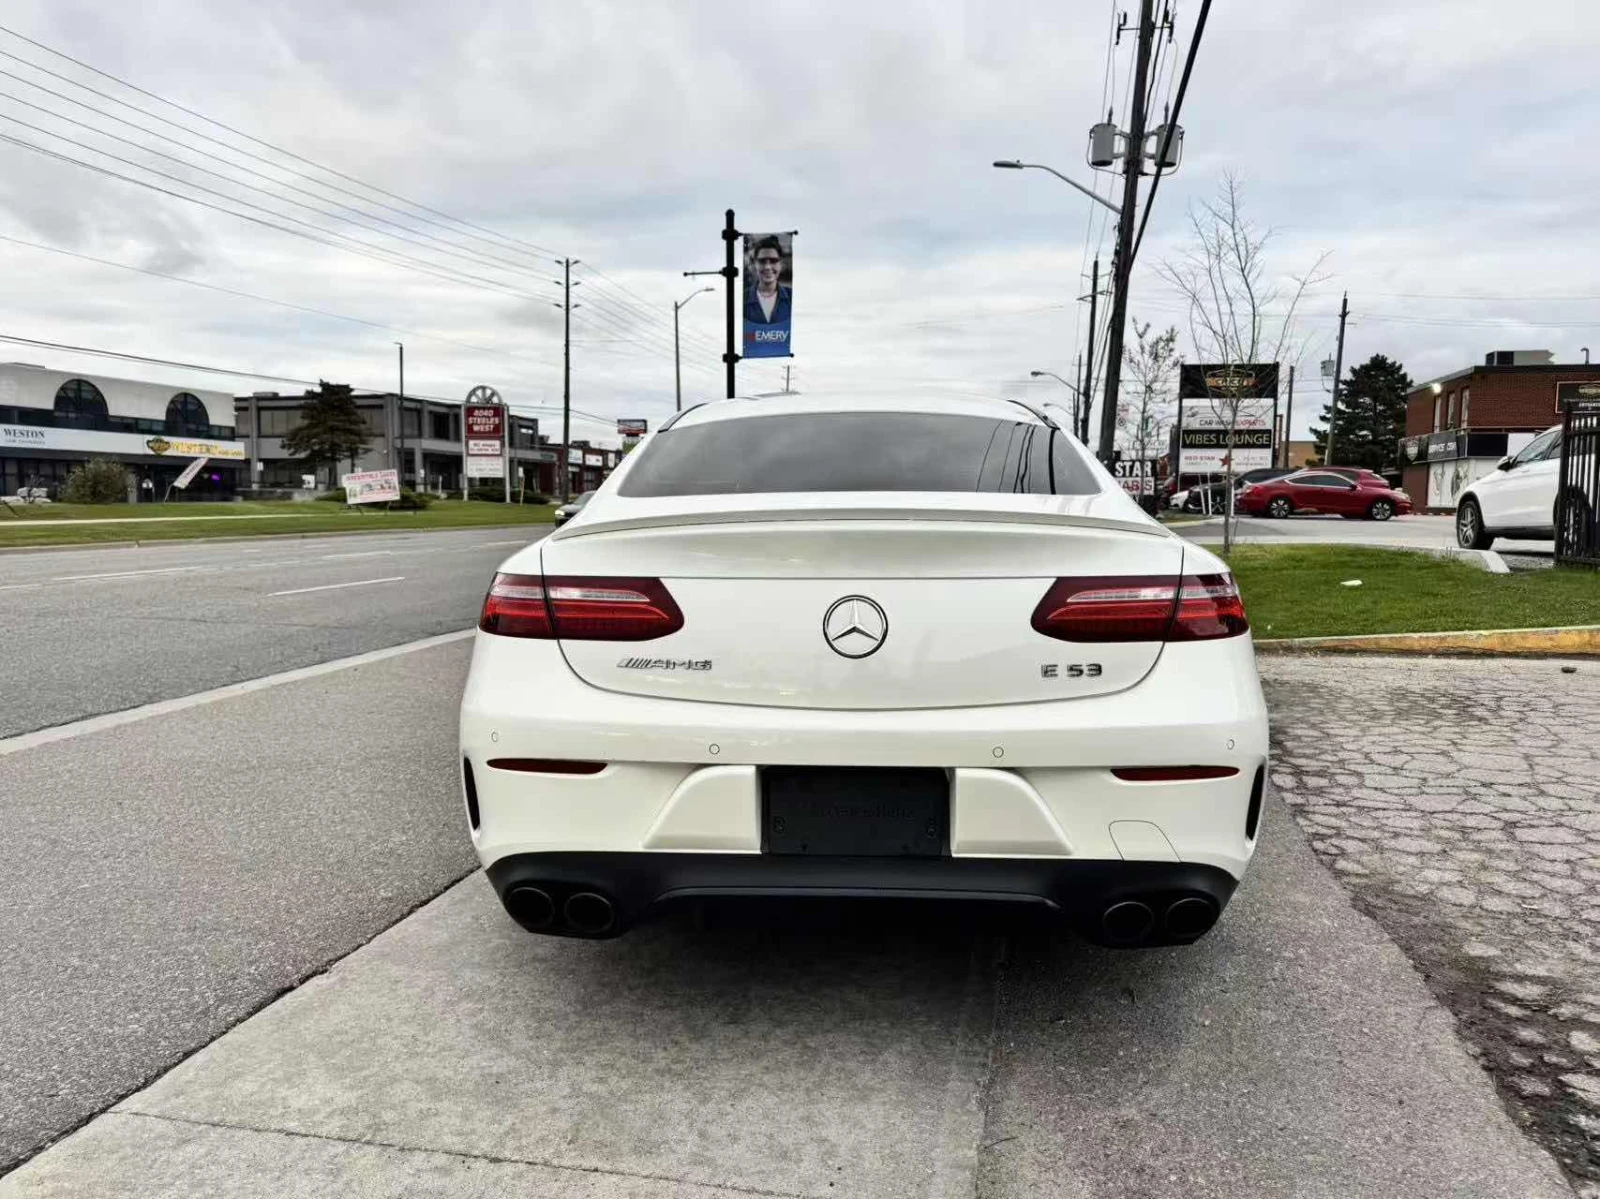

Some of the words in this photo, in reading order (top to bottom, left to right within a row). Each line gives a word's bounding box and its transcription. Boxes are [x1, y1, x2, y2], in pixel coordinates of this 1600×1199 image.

[755, 330, 789, 342] EMERY
[468, 416, 500, 425] STEELES
[1199, 419, 1213, 427] CAR
[3, 428, 45, 438] WESTON
[473, 424, 495, 432] WEST
[1184, 433, 1217, 445] VIBES
[1219, 433, 1270, 445] LOUNGE
[1115, 460, 1152, 477] STAR
[650, 658, 713, 671] AMG
[1041, 664, 1059, 678] E
[1066, 663, 1103, 678] 53
